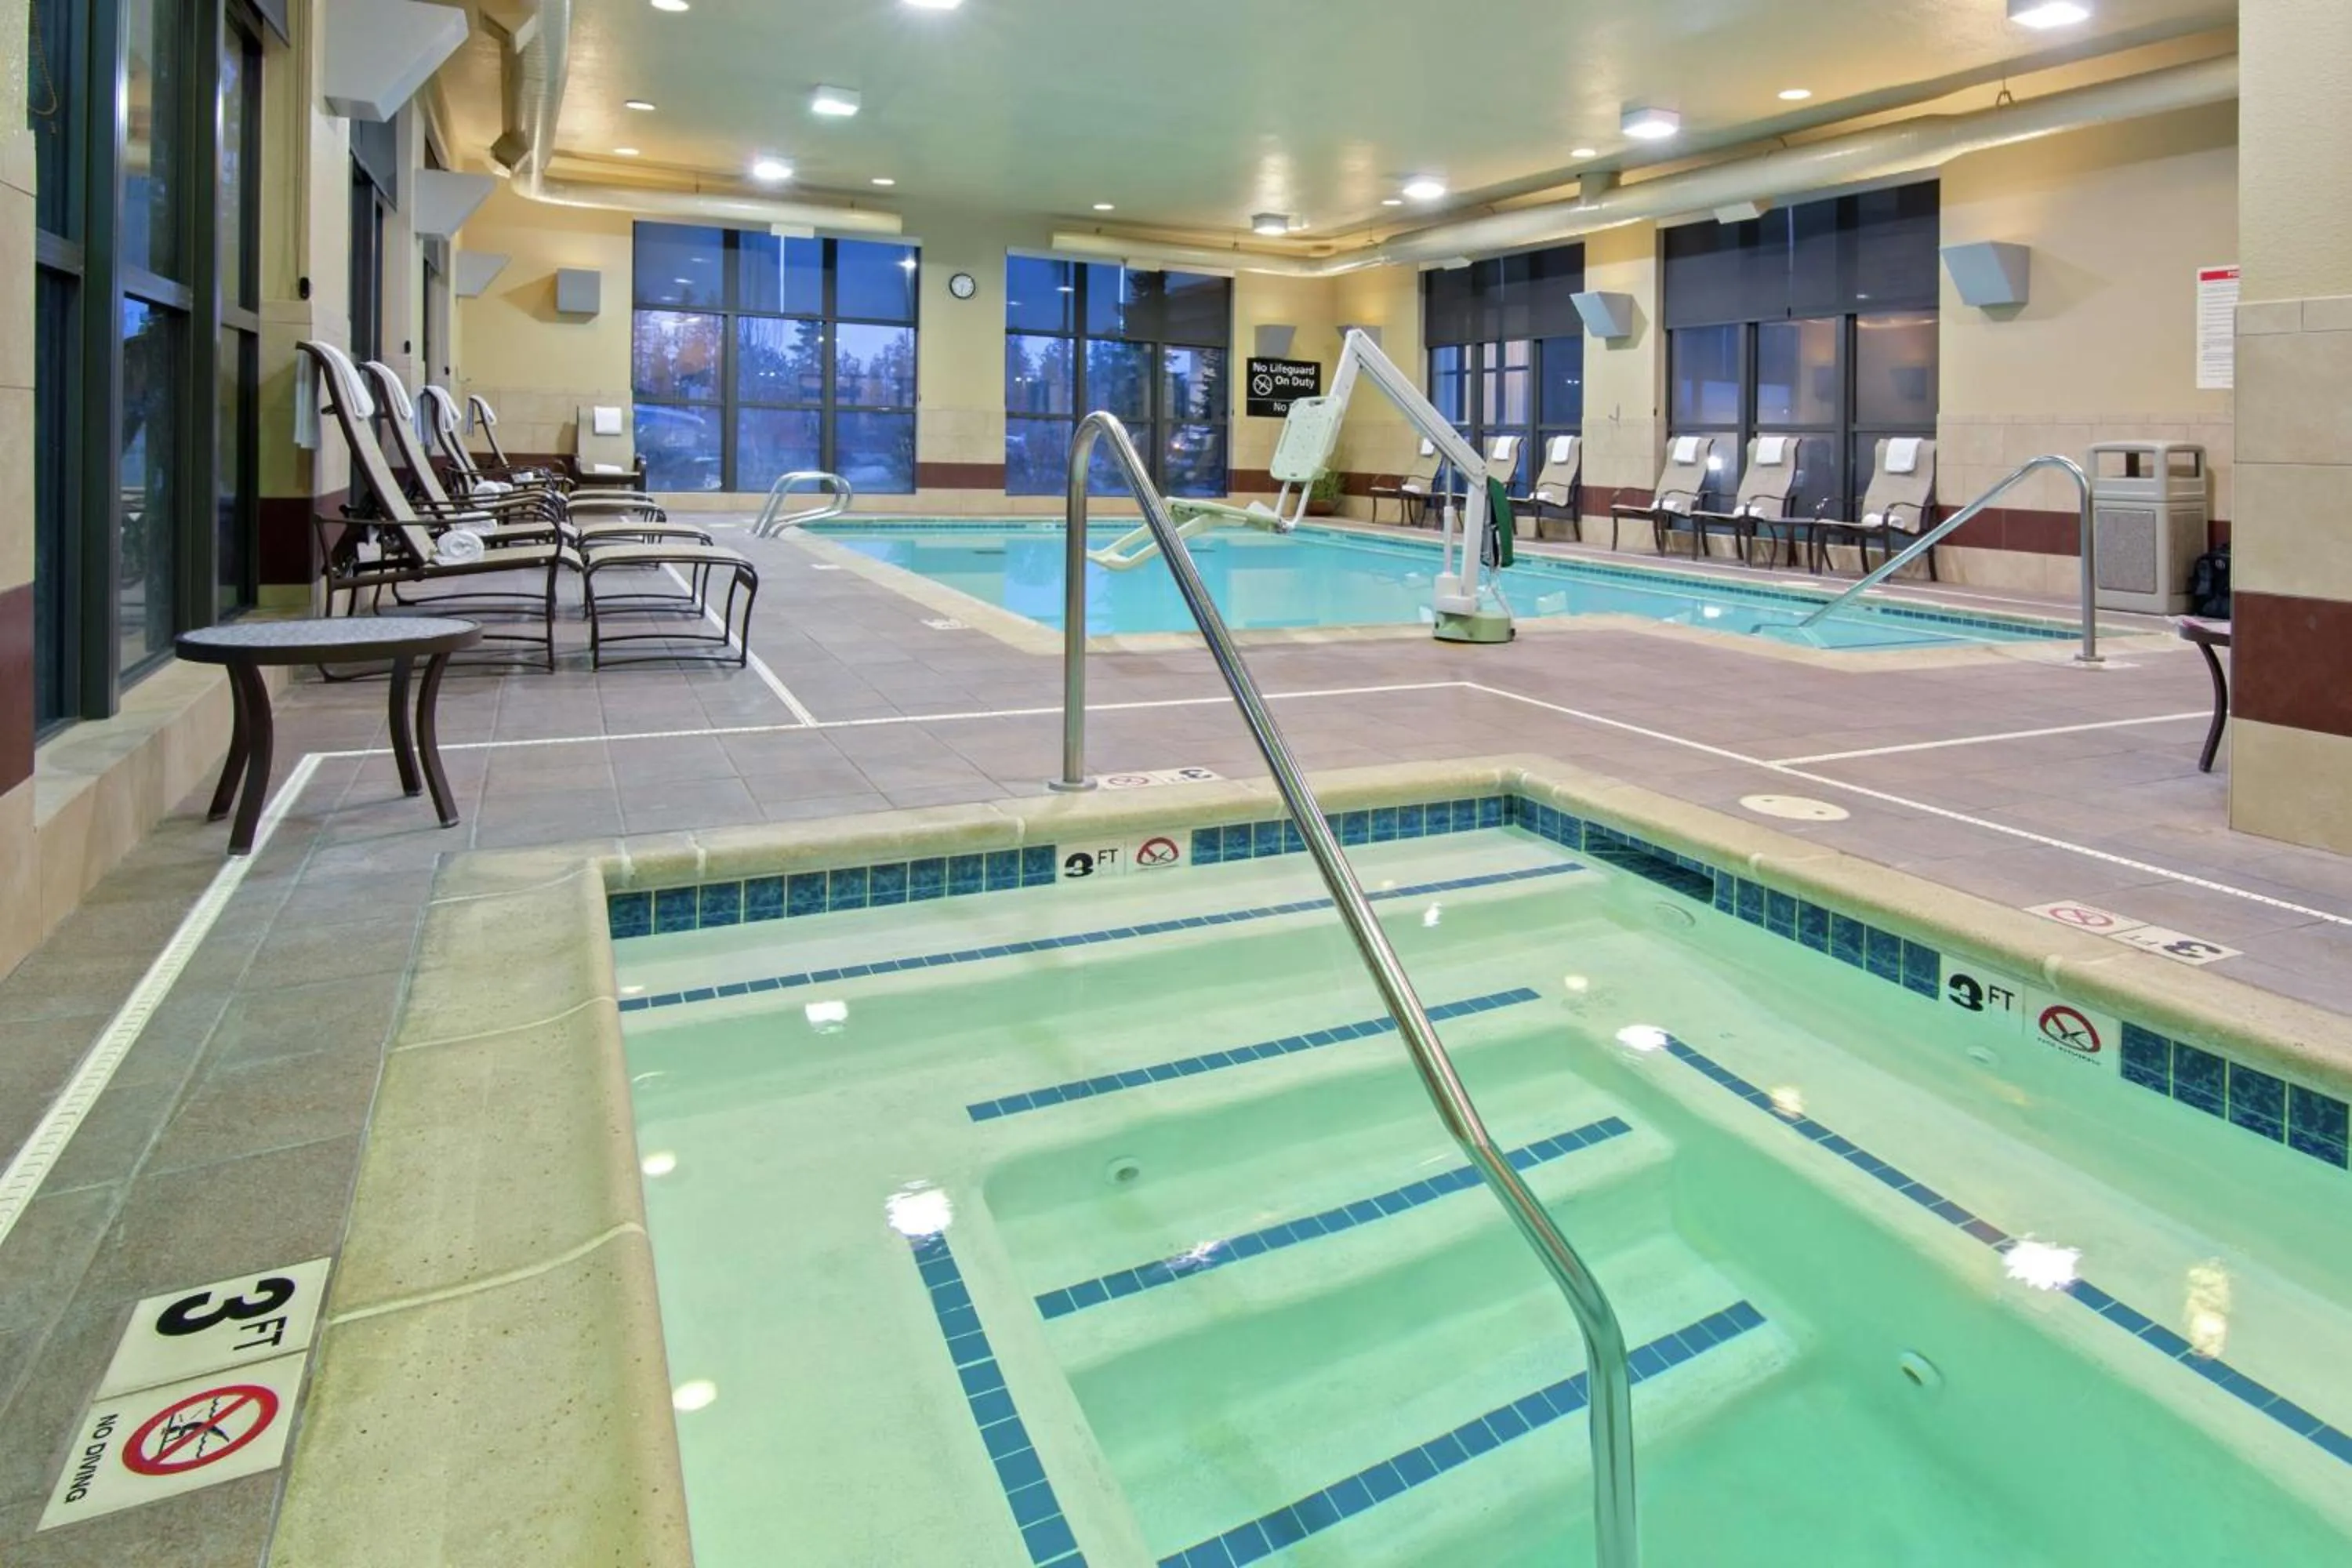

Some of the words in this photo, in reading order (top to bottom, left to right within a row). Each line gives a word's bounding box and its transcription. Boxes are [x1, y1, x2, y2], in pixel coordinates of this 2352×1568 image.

[1253, 362, 1267, 372] No
[1270, 364, 1315, 376] Lifeguard
[1275, 376, 1289, 385] On
[1291, 376, 1314, 389] Duty
[1273, 401, 1287, 412] No
[1064, 853, 1094, 877] 3
[1098, 849, 1118, 865] FT
[2162, 940, 2223, 959] 3
[1948, 974, 1984, 1011] 3
[1989, 985, 2015, 1011] FT
[156, 1277, 295, 1336] 3
[233, 1317, 286, 1350] FT
[93, 1414, 118, 1439] NO
[65, 1443, 107, 1503] DIVING
